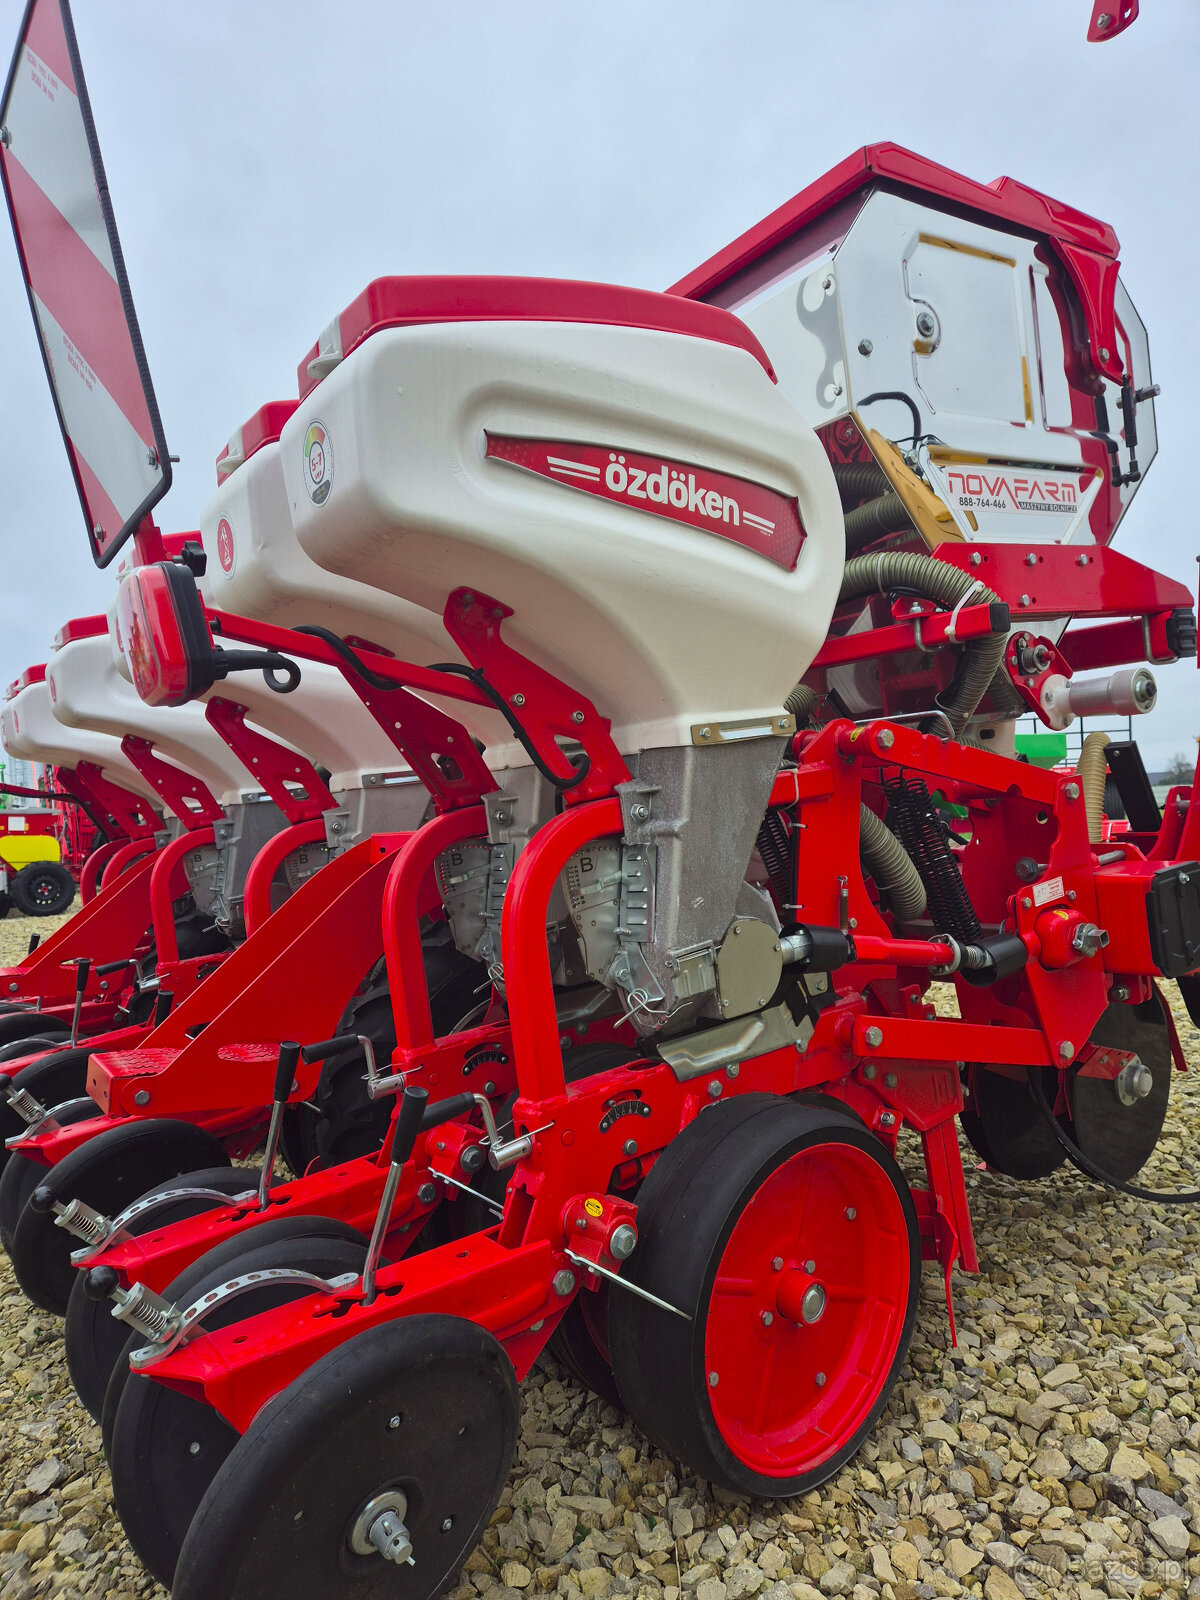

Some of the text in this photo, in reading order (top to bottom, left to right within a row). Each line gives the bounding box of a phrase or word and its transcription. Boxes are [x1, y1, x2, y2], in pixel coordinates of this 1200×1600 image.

[605, 453, 740, 527] özdöken
[948, 472, 1077, 510] NOVAFARM
[959, 497, 1007, 509] 888-764-466
[1021, 503, 1078, 513] MASZYNY ROLNICZE
[194, 854, 202, 862] B
[299, 854, 309, 864] B
[451, 853, 463, 866] B
[580, 857, 593, 873] B
